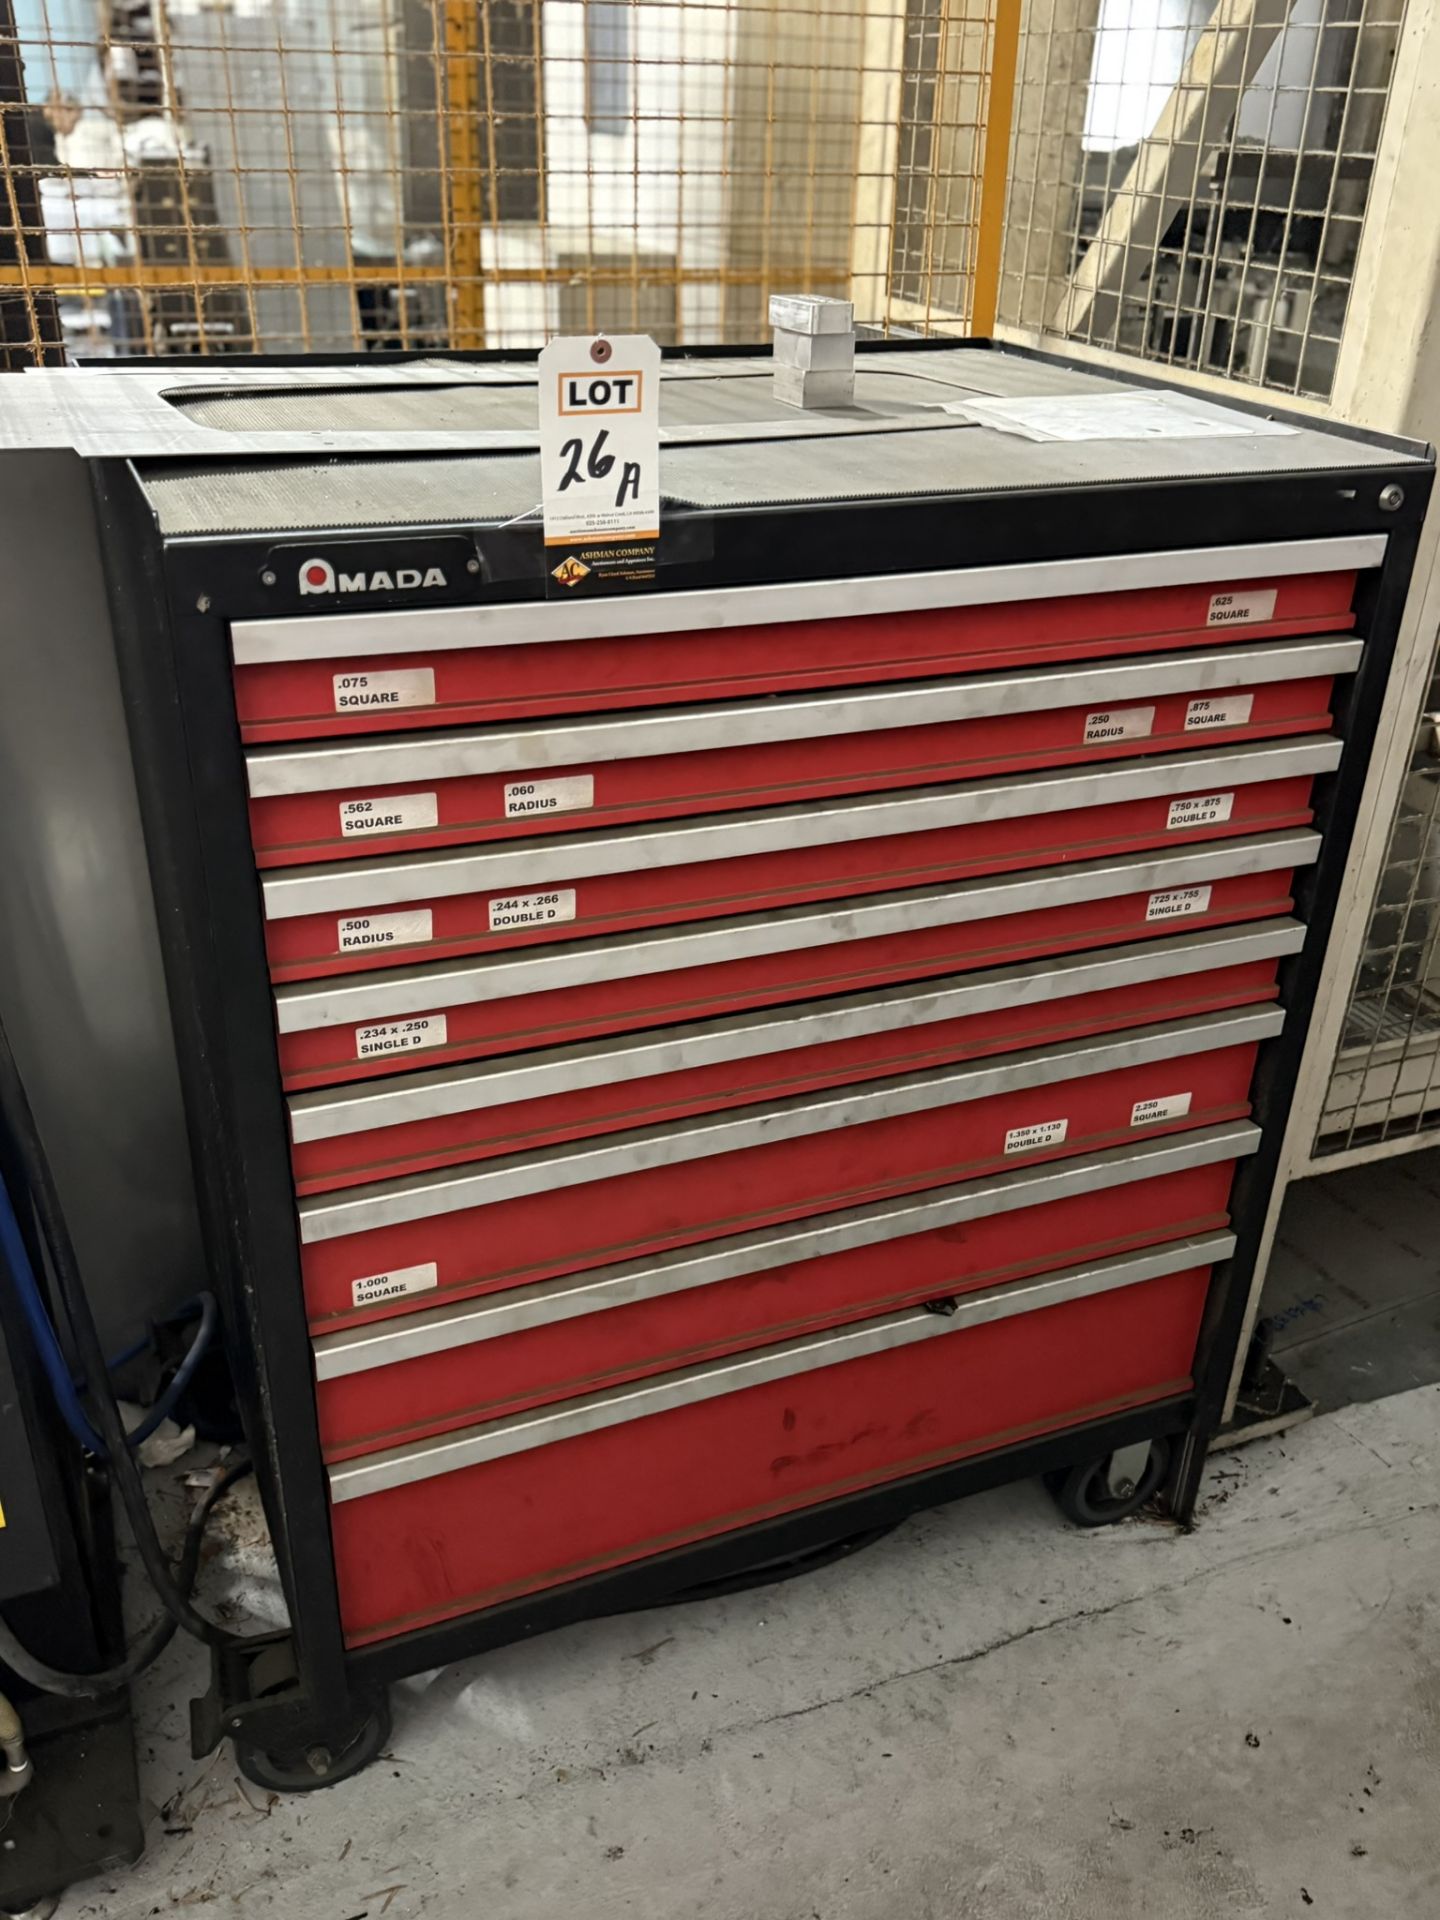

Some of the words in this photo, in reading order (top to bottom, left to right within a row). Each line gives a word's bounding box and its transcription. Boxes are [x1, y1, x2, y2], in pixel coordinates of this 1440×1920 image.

[569, 380, 633, 406] LOT
[557, 429, 616, 491] 26
[580, 550, 615, 560] ASHMAN
[615, 546, 655, 557] COMPANY
[299, 558, 447, 595] AMADA
[1212, 596, 1233, 607] .625
[1210, 609, 1250, 621] SQUARE
[338, 677, 368, 689] .075
[339, 692, 399, 706] SQUARE
[1190, 701, 1210, 712] .875
[1088, 715, 1110, 725] .250
[1187, 713, 1226, 725] SQUARE
[1086, 726, 1124, 739] RADIUS
[508, 785, 535, 797] .060
[343, 802, 373, 815] .562
[508, 798, 557, 812] RADIUS
[1171, 801, 1191, 812] .750
[1201, 797, 1221, 807] .875
[345, 815, 403, 830] SQUARE
[1170, 811, 1207, 825] DOUBLE
[1209, 811, 1216, 819] D
[492, 900, 519, 913] .244
[532, 894, 559, 907] .266
[1150, 894, 1170, 905] .725
[1149, 904, 1182, 916] SINGLE
[1184, 903, 1191, 911] D
[493, 910, 544, 927] DOUBLE
[547, 909, 556, 919] D
[341, 920, 370, 932] .500
[343, 932, 394, 947] RADIUS
[360, 1027, 387, 1040] .234
[402, 1020, 429, 1032] .250
[361, 1037, 408, 1054] SINGLE
[413, 1036, 422, 1044] D
[1135, 1101, 1158, 1112] 2.250
[1133, 1109, 1168, 1122] SQUARE
[1009, 1128, 1031, 1139] 1.350
[1040, 1123, 1061, 1134] 1.130
[1007, 1136, 1043, 1150] DOUBLE
[1044, 1134, 1052, 1142] D
[356, 1276, 388, 1289] 1.000
[357, 1283, 407, 1302] SQUARE
